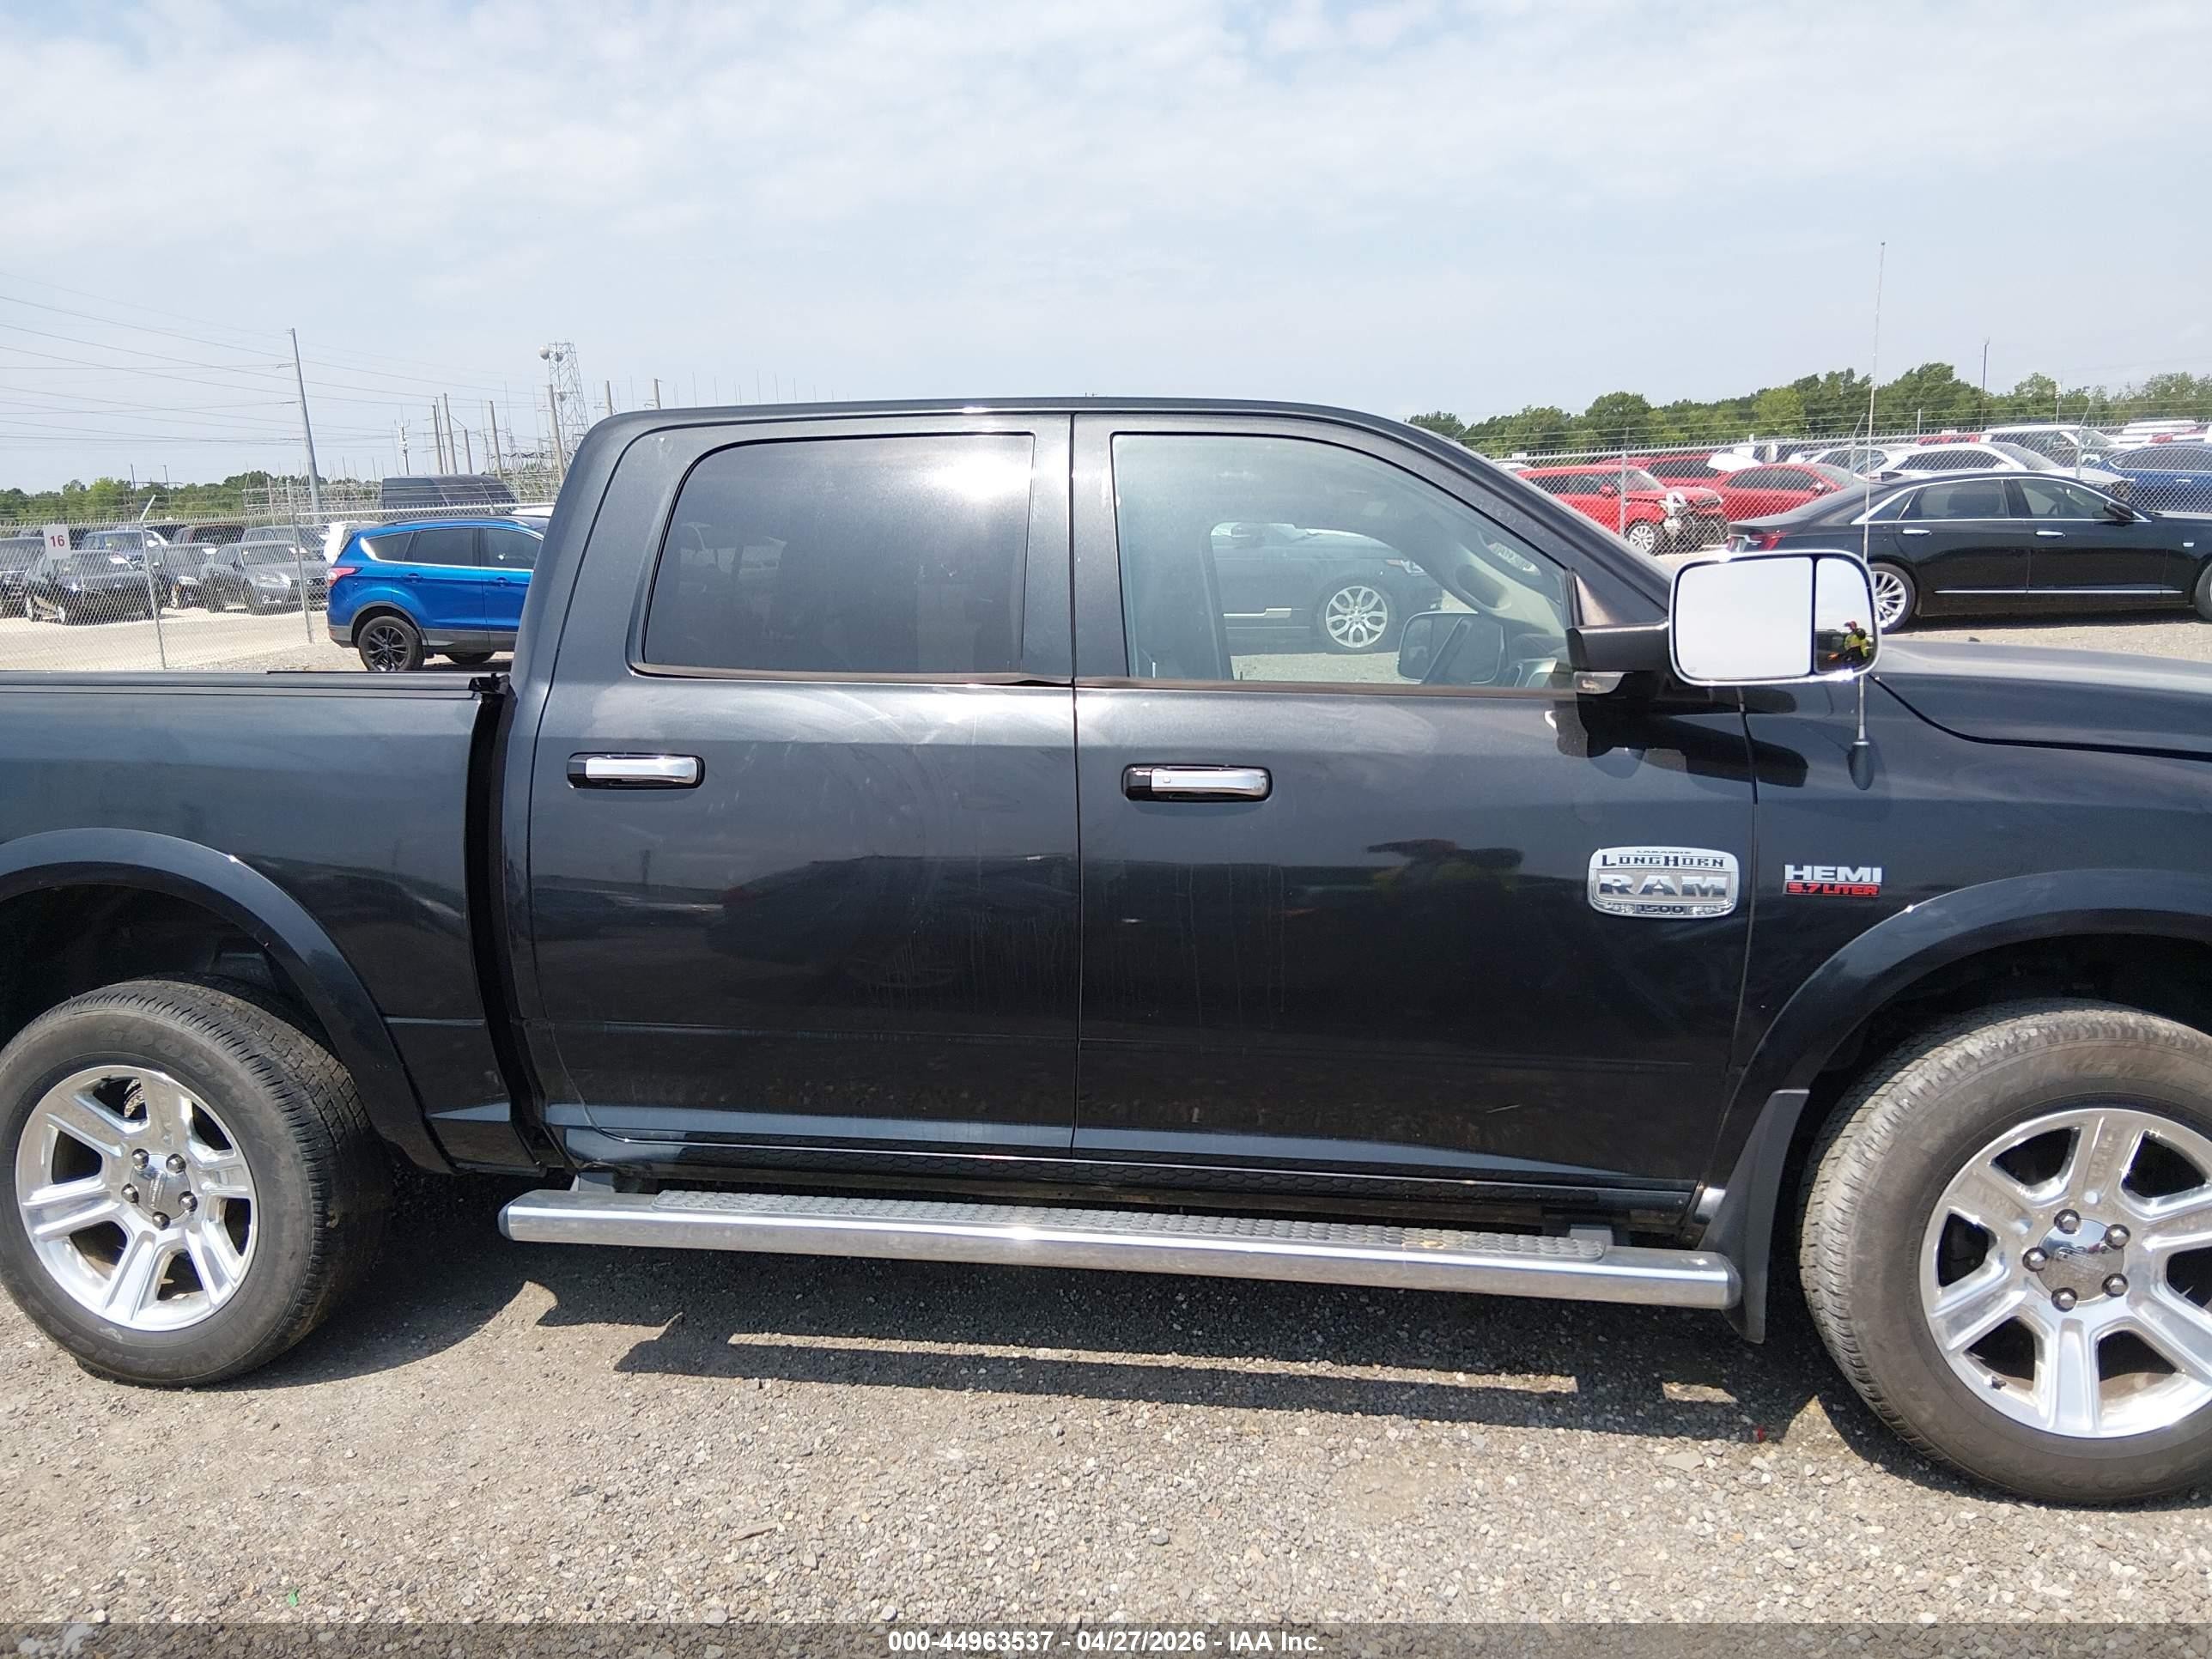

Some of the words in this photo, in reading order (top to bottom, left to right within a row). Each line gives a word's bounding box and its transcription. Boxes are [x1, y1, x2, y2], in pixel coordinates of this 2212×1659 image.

[50, 534, 65, 547] 16
[1784, 865, 1882, 883] HEMI
[1599, 874, 1728, 896] RAM
[1788, 883, 1820, 893] 5.7
[1822, 884, 1879, 895] LITER
[1639, 904, 1685, 915] 1500
